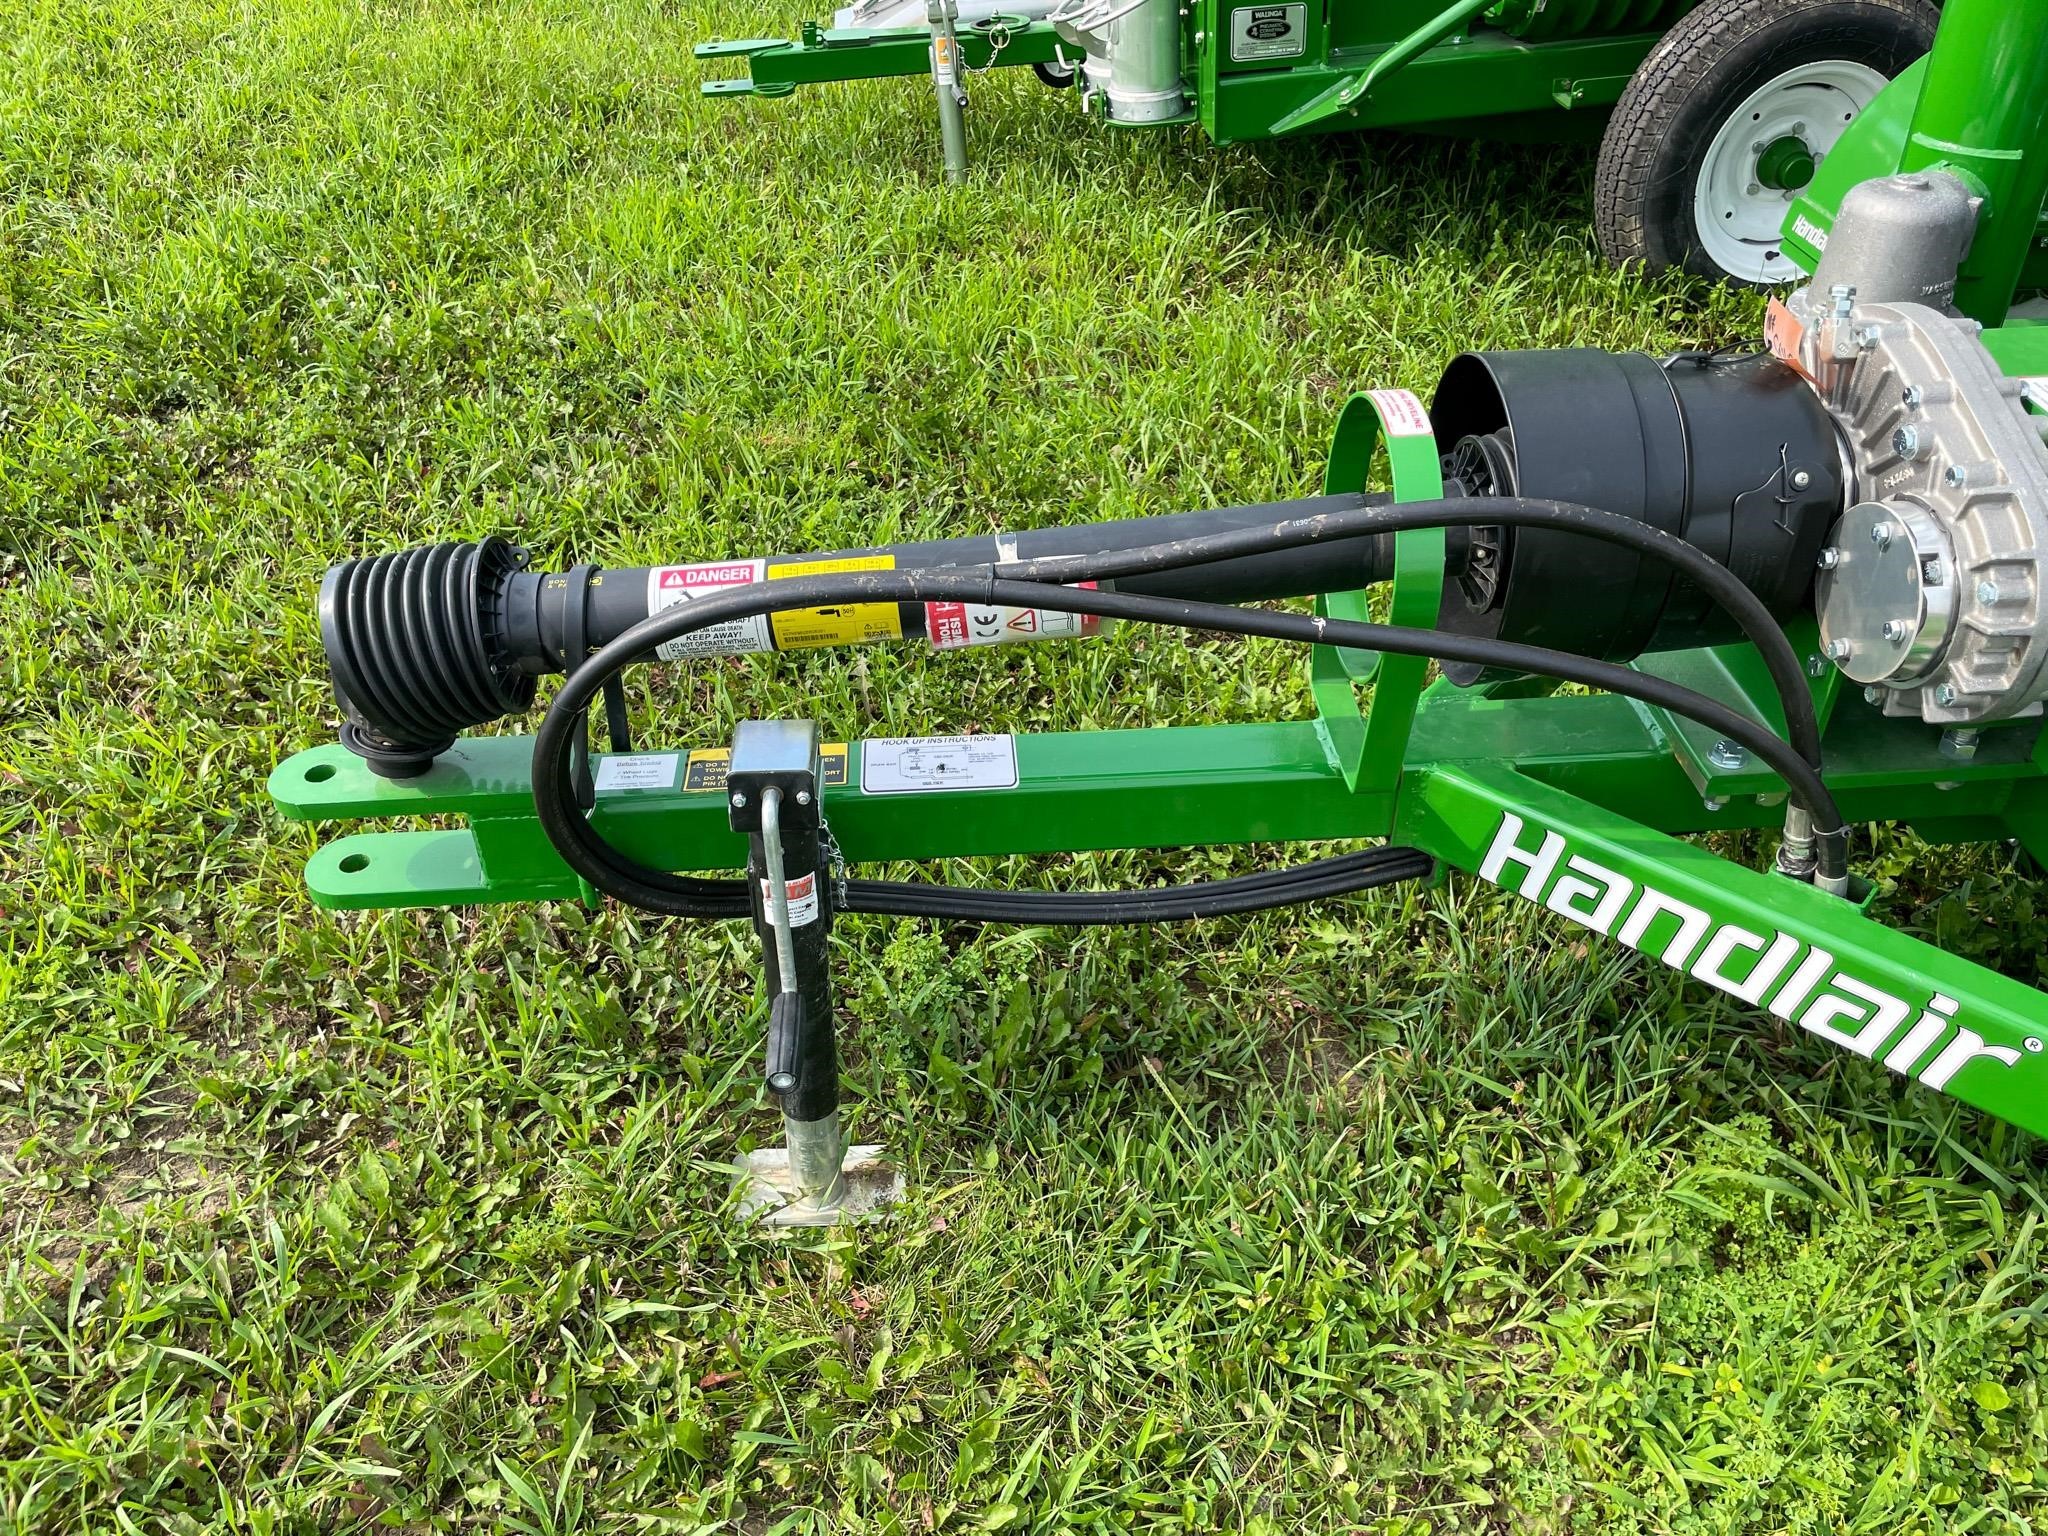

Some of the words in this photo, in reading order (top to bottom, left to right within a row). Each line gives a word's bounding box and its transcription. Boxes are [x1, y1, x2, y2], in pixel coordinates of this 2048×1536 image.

[1791, 213, 1829, 252] Handla
[685, 567, 751, 584] DANGER
[686, 633, 711, 641] KEEP
[712, 631, 742, 640] AWAY!
[695, 640, 725, 648] OPERATE
[926, 736, 997, 744] INSTRUCTIONS
[1478, 810, 2024, 1093] Handlair
